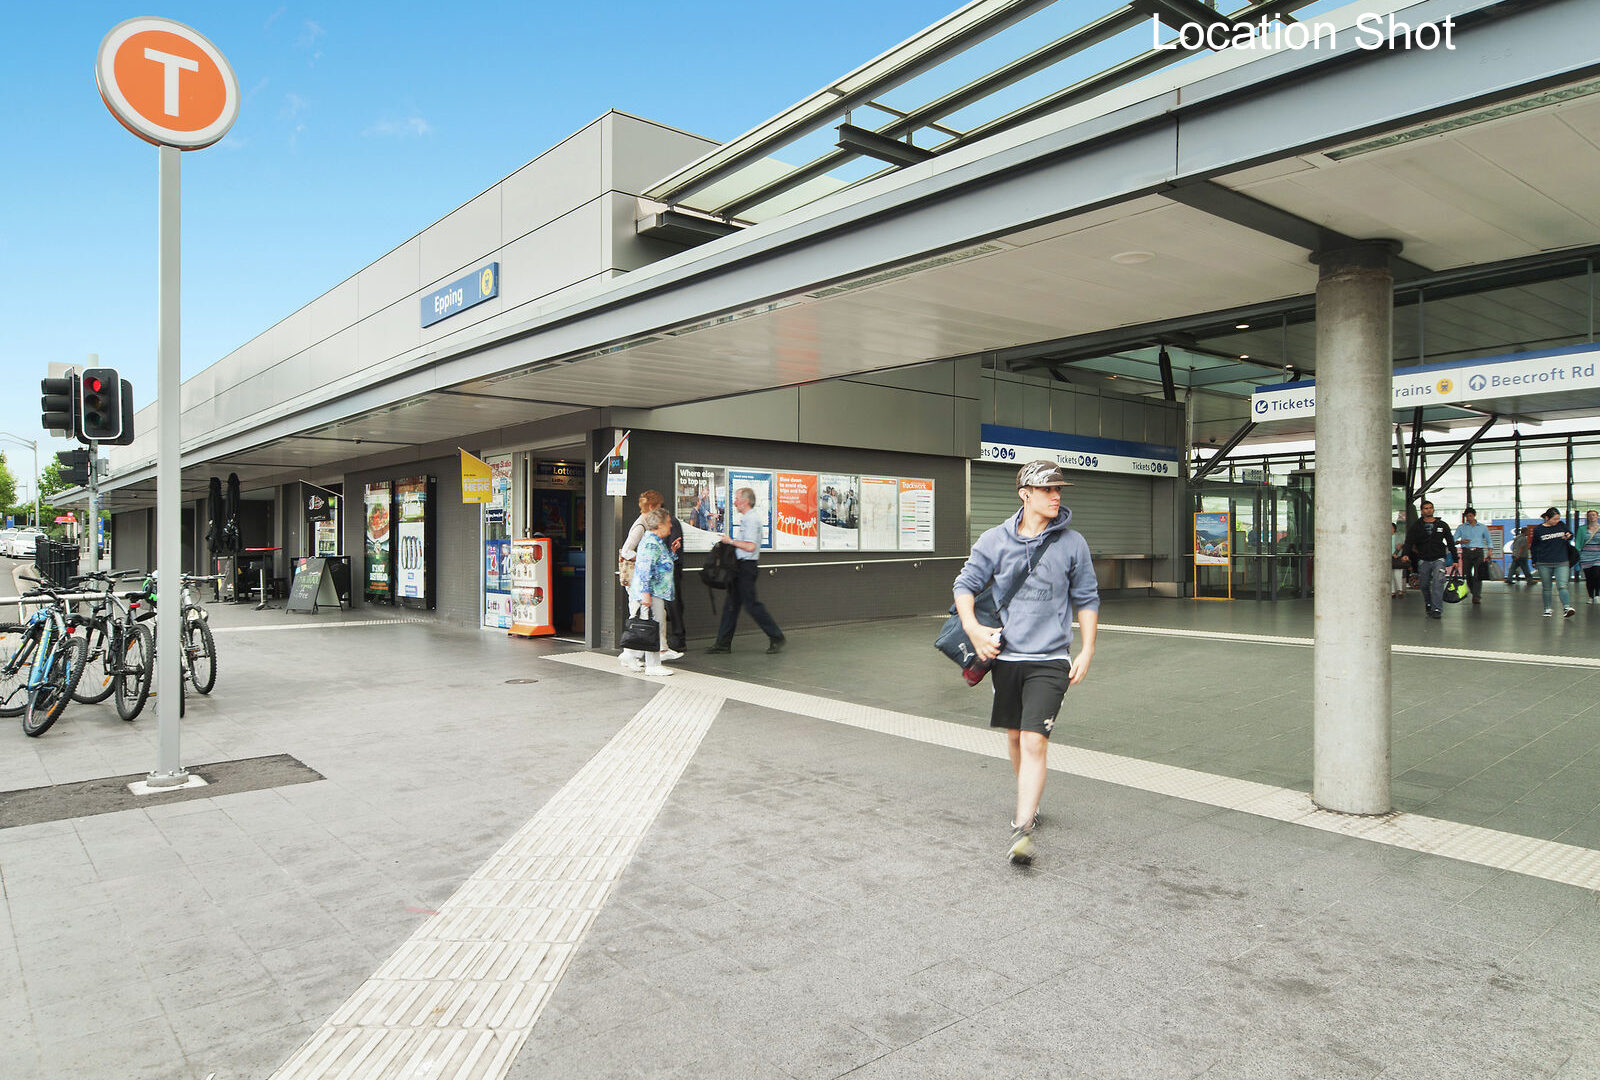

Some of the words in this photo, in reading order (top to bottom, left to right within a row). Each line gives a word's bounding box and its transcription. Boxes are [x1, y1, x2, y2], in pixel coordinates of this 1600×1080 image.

[144, 47, 198, 117] T
[434, 288, 463, 314] Epping
[1490, 367, 1565, 387] Beecroft
[1572, 364, 1594, 379] Rd
[1271, 396, 1315, 412] Tickets
[1056, 454, 1077, 465] Tickets
[1132, 461, 1150, 471] Tickets
[680, 469, 700, 478] Where
[702, 470, 714, 478] else
[463, 483, 490, 492] HERE
[688, 478, 698, 486] top
